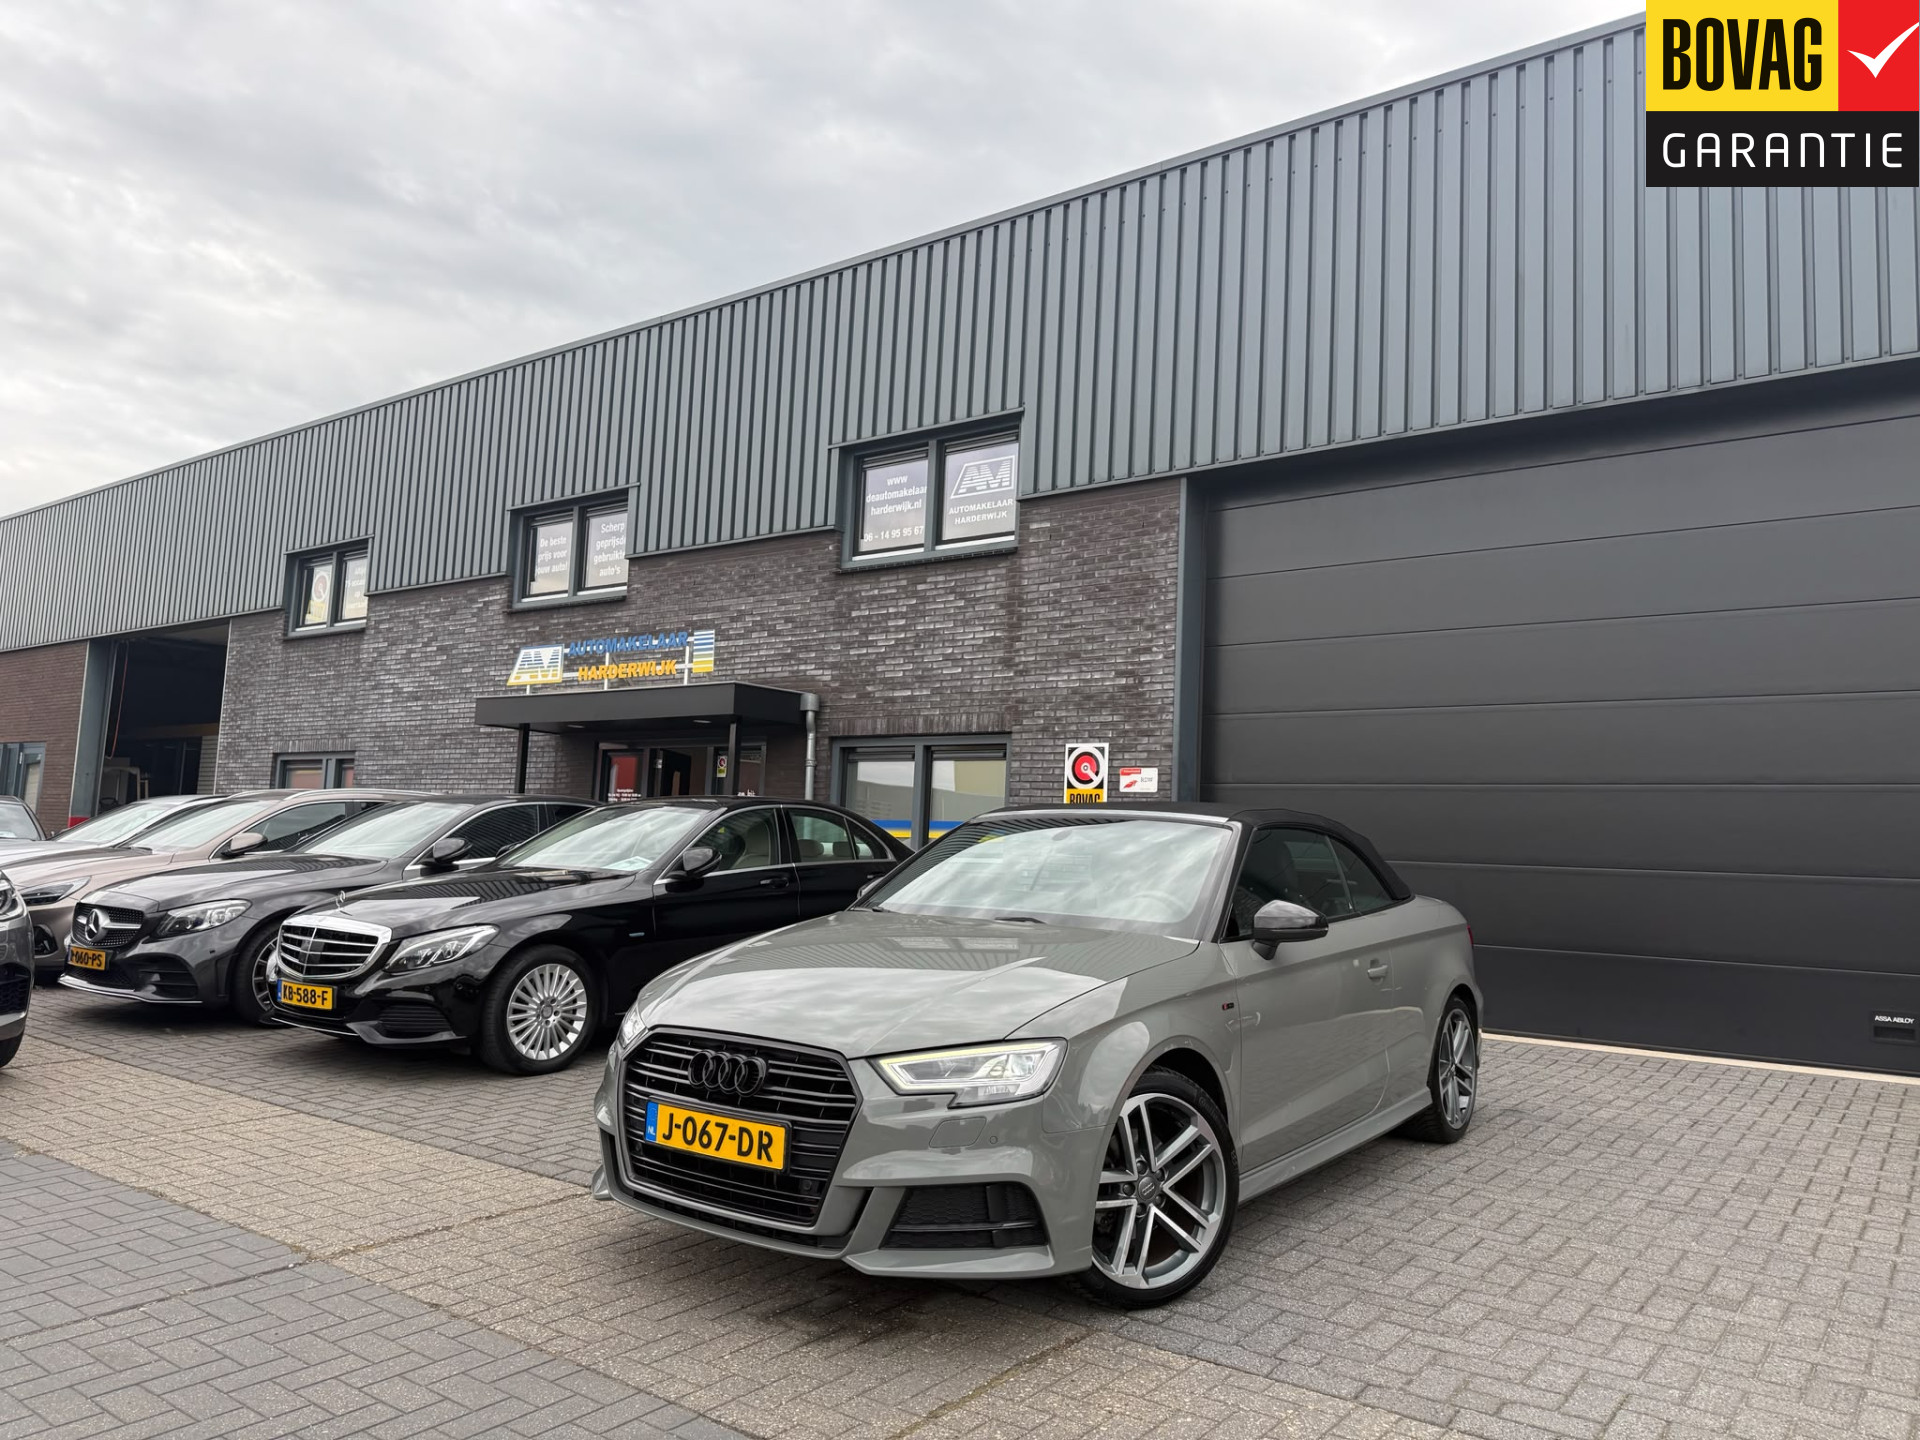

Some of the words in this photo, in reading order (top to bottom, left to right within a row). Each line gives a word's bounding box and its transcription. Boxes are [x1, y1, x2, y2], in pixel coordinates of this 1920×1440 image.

[886, 475, 908, 487] www
[870, 499, 922, 517] harderwijk.nl
[949, 498, 1014, 515] AUTOMAKELAAR
[954, 510, 1008, 525] HARDERWIJK
[601, 523, 625, 534] Scherp
[863, 532, 873, 543] 06
[880, 529, 890, 540] 14
[891, 528, 901, 539] 95
[903, 527, 913, 537] 95
[914, 525, 924, 535] 67
[540, 539, 549, 548] De
[550, 536, 567, 547] beste
[538, 551, 552, 563] prijs
[553, 550, 568, 559] voor
[599, 565, 621, 577] auto's
[567, 631, 689, 657] AUTOMAKELAAR
[577, 659, 677, 682] HARDERWIJK
[283, 983, 329, 1006] KB-588-F
[1893, 1016, 1915, 1024] ABLOY
[647, 1125, 656, 1136] NL
[662, 1112, 773, 1163] J-067-DR
